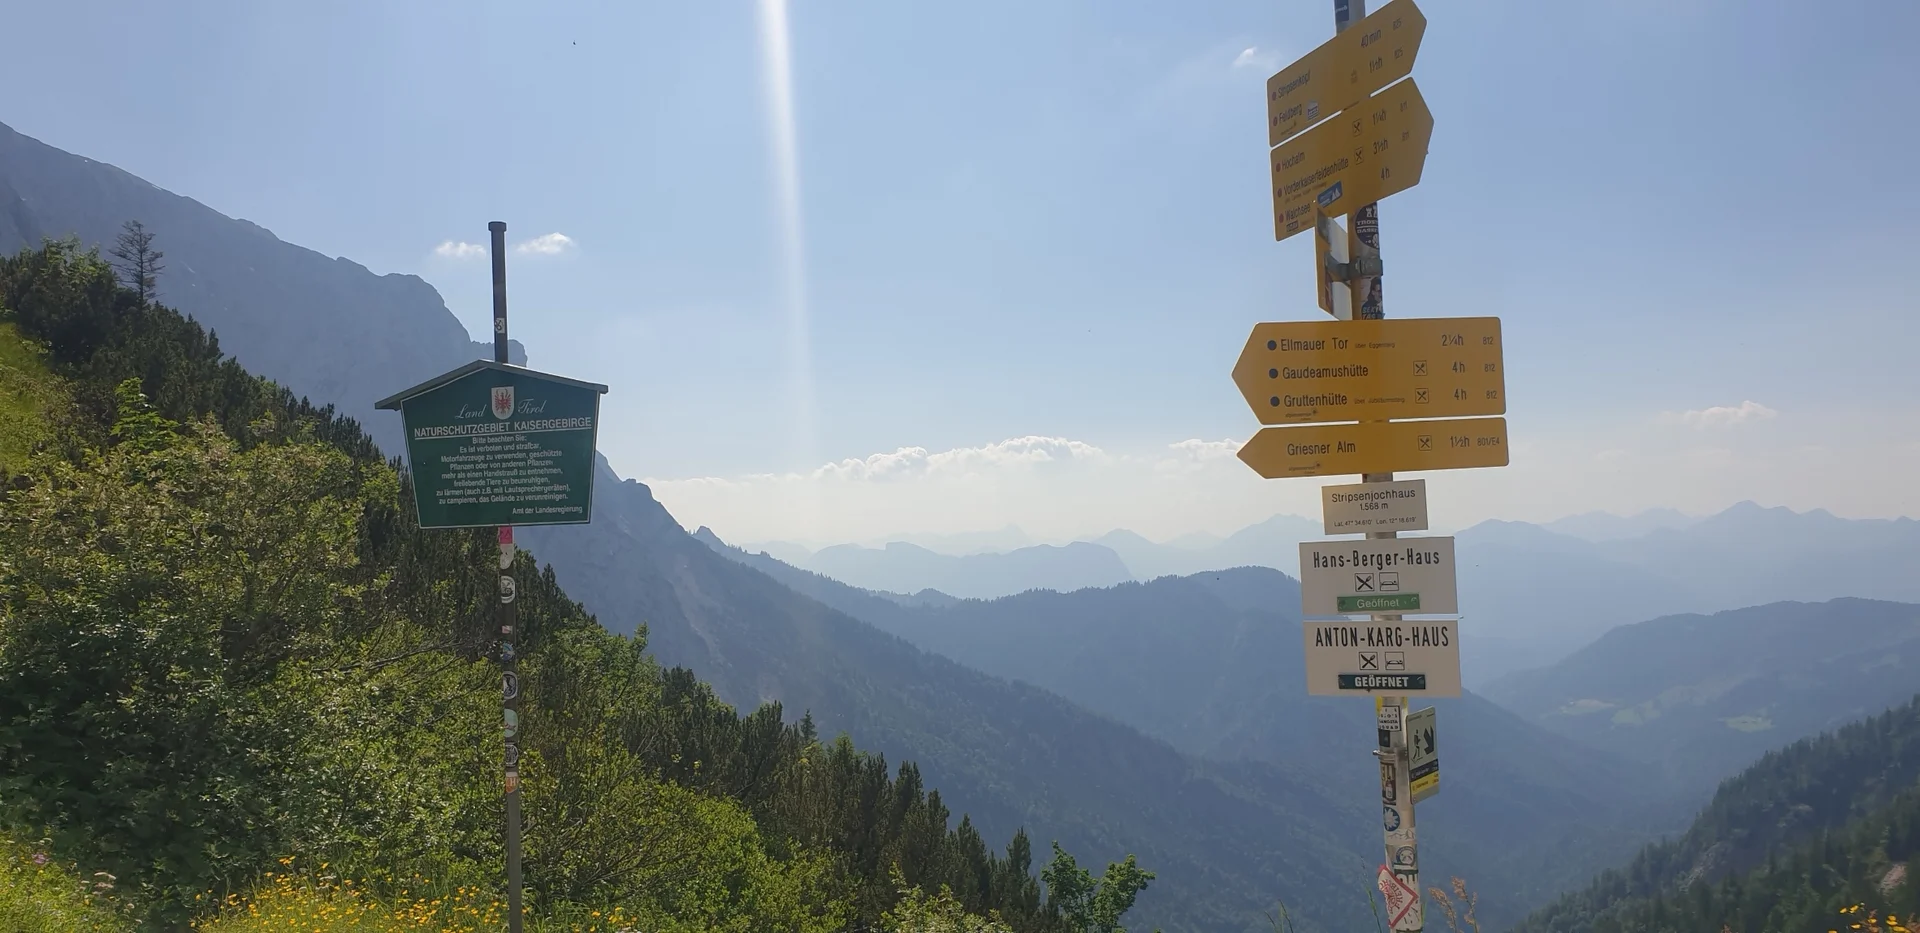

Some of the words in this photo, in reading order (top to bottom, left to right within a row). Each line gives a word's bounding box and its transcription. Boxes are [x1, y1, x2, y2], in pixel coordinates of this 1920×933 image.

[1280, 338, 1326, 351] Ellmauer
[1332, 337, 1349, 350] Tor
[1482, 336, 1494, 346] 812
[1282, 364, 1369, 380] Gaudeamushütte
[1484, 363, 1496, 373] 812
[1284, 392, 1348, 408] Gruttenhütte
[1486, 390, 1498, 400] 812
[454, 404, 487, 420] Land
[518, 398, 547, 414] Tirol
[414, 422, 510, 438] NATURSCHUTZGEBIET
[514, 417, 592, 432] KAISERGEBIRGE
[476, 444, 502, 452] verboten
[1287, 442, 1330, 456] Griesner
[1336, 441, 1356, 454] Alm
[440, 454, 485, 464] Motorfahrzeuge
[529, 450, 562, 460] geschützte
[450, 462, 474, 470] Pflanzen
[502, 460, 526, 468] anderen
[527, 458, 554, 467] Pflanzen
[466, 470, 483, 478] einen
[484, 468, 518, 477] Handstrauß
[454, 478, 486, 487] freilebende
[486, 478, 501, 486] Tiere
[444, 488, 463, 496] lärmen
[464, 488, 480, 496] (auch
[490, 494, 516, 503] Gelände
[1331, 488, 1416, 504] Stripsenjochhaus
[535, 506, 583, 516] Landesregierung
[1359, 502, 1380, 511] 1.568
[1313, 548, 1440, 570] Hans-Berger-Haus
[1356, 598, 1400, 609] Geöffnet
[1315, 626, 1449, 648] ANTON-KARG-HAUS
[1354, 674, 1409, 688] GEÖFFNET
